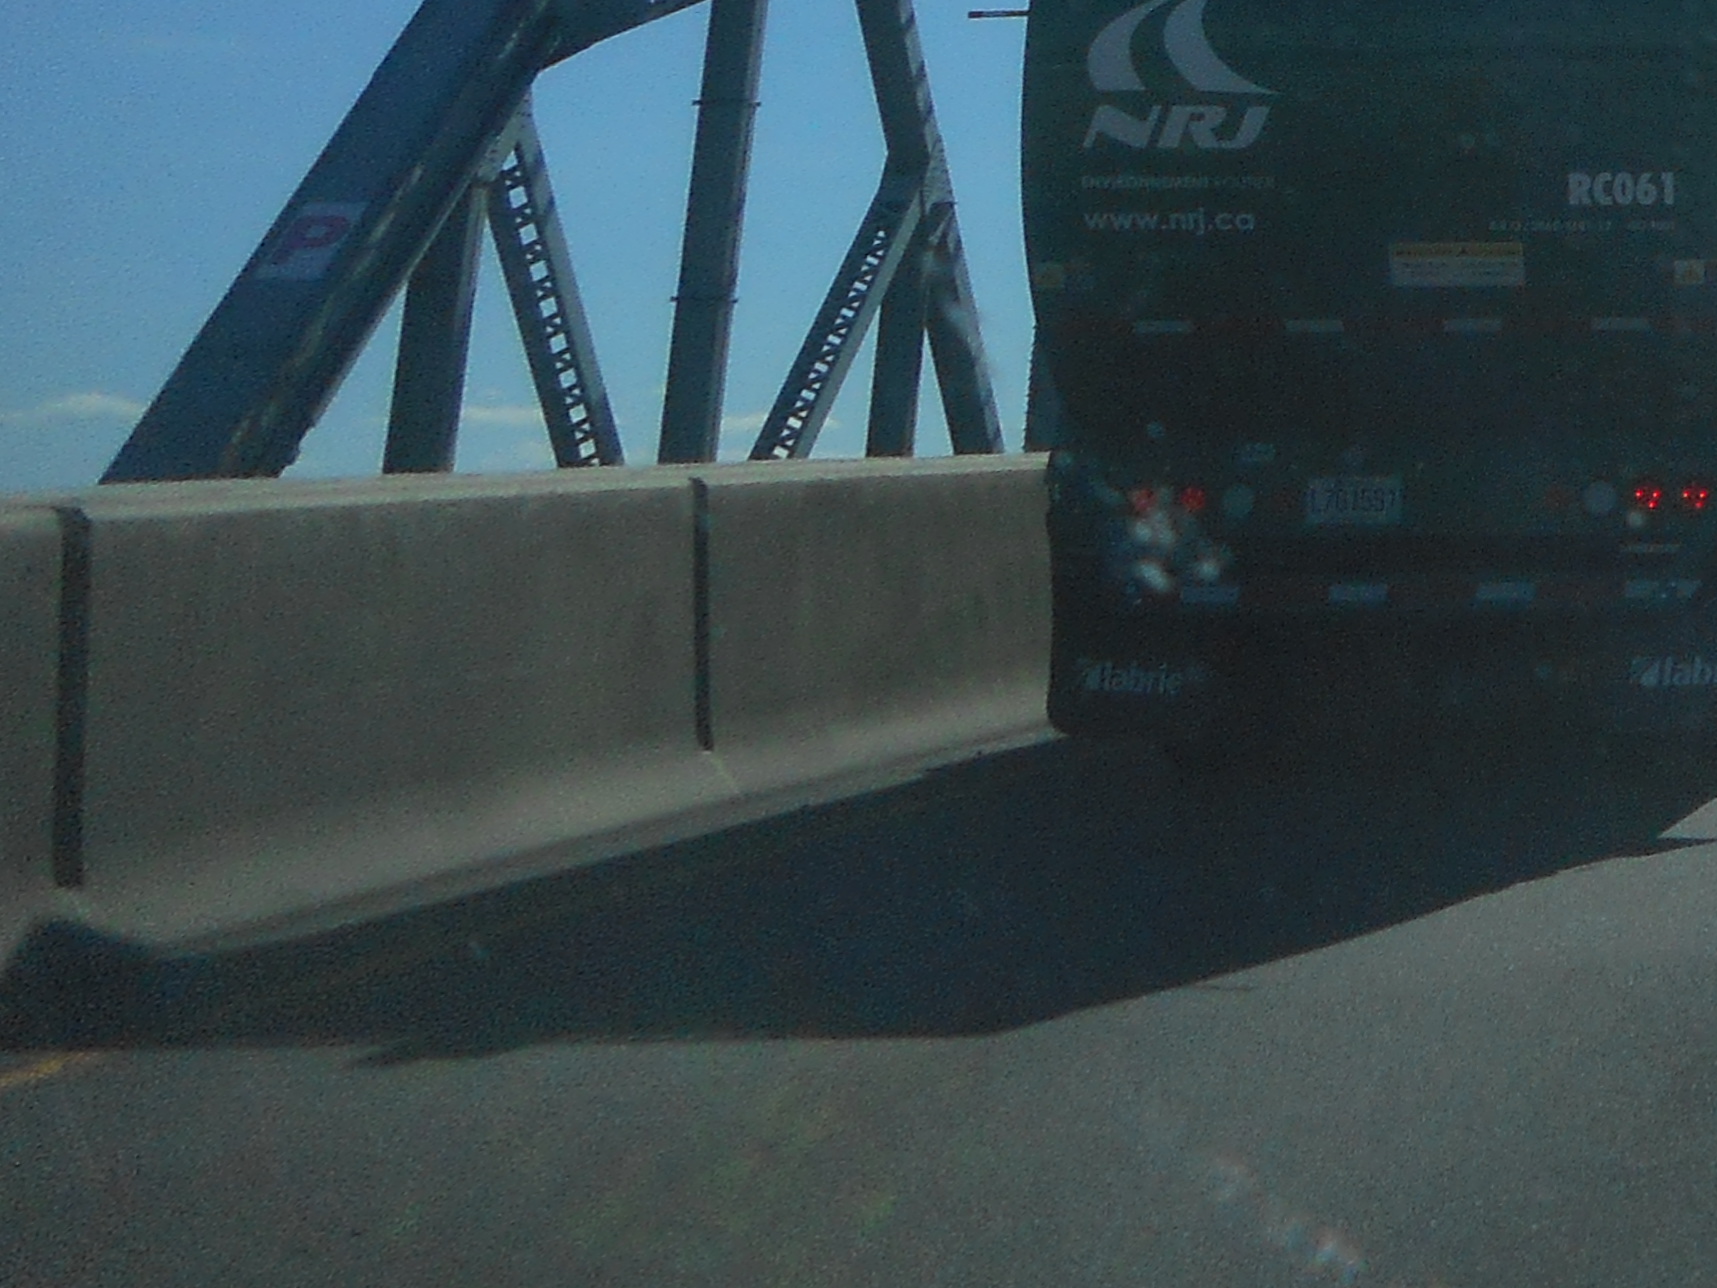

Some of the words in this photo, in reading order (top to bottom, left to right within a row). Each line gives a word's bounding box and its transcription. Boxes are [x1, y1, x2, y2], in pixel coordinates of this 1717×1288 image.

[1083, 104, 1271, 149] NRJ
[1567, 171, 1676, 206] RC061
[1083, 208, 1256, 236] www.nrj.ca
